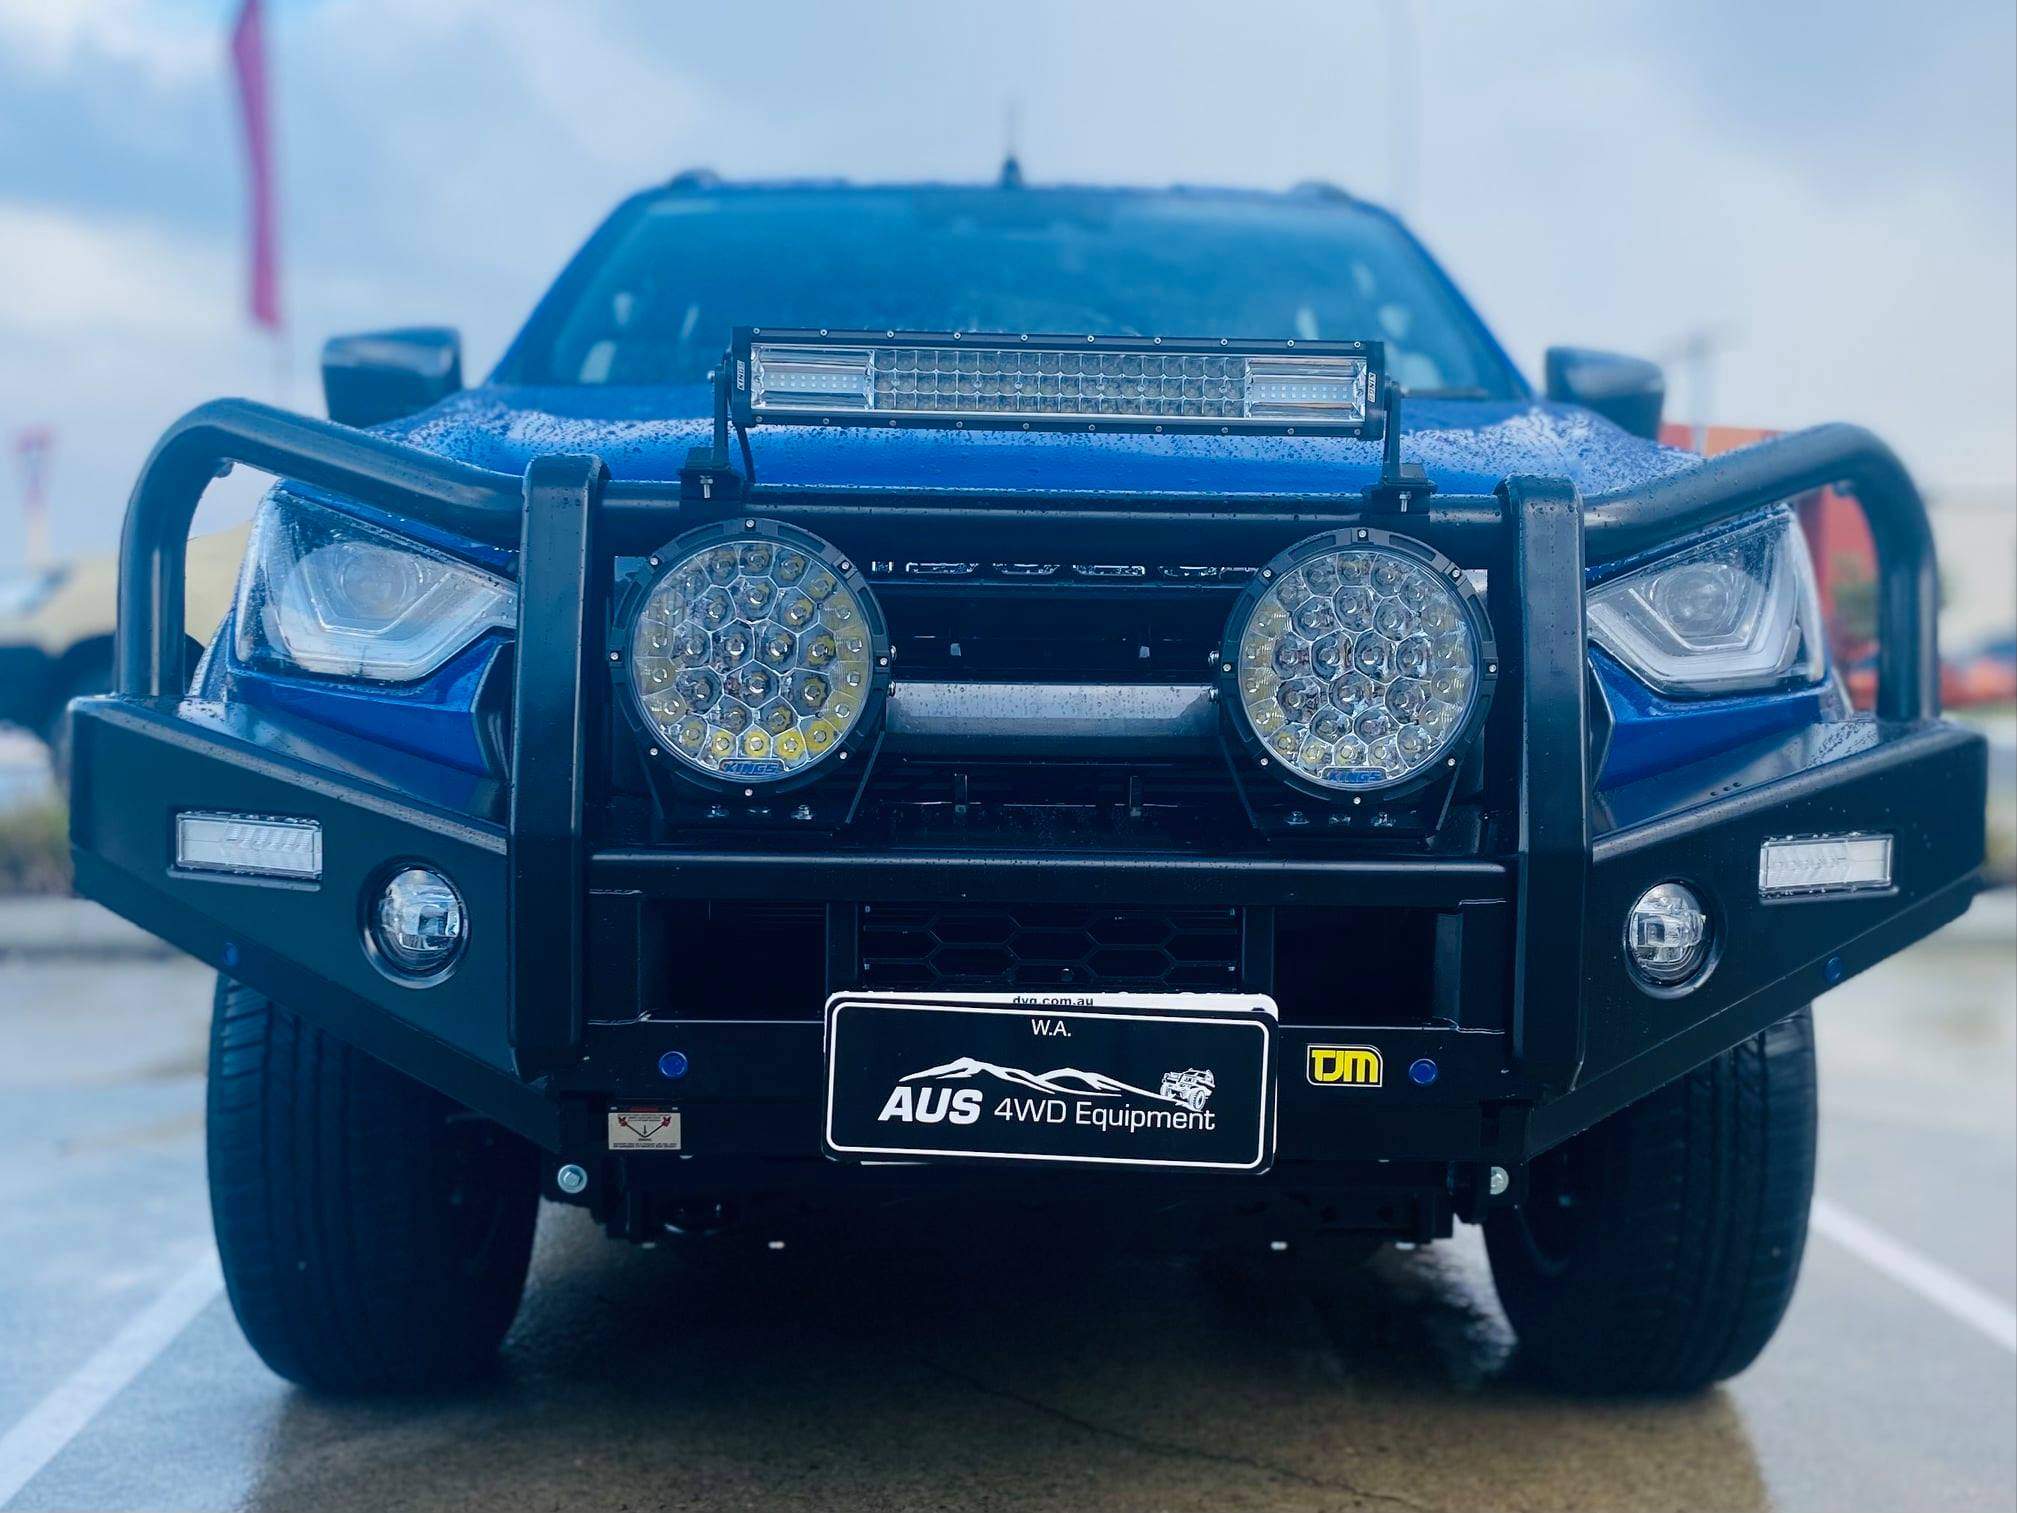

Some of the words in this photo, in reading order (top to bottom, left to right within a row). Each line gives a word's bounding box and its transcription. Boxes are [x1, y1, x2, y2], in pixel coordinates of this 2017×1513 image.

[723, 761, 780, 775] KINGS
[1327, 769, 1381, 784] KINGS
[1012, 996, 1094, 1007] dvgcom.au
[1031, 1018, 1072, 1037] W.A.
[1311, 1050, 1379, 1083] TJM
[878, 1086, 984, 1125] AUS
[993, 1097, 1067, 1124] 4WD
[1075, 1101, 1216, 1133] Equipment
